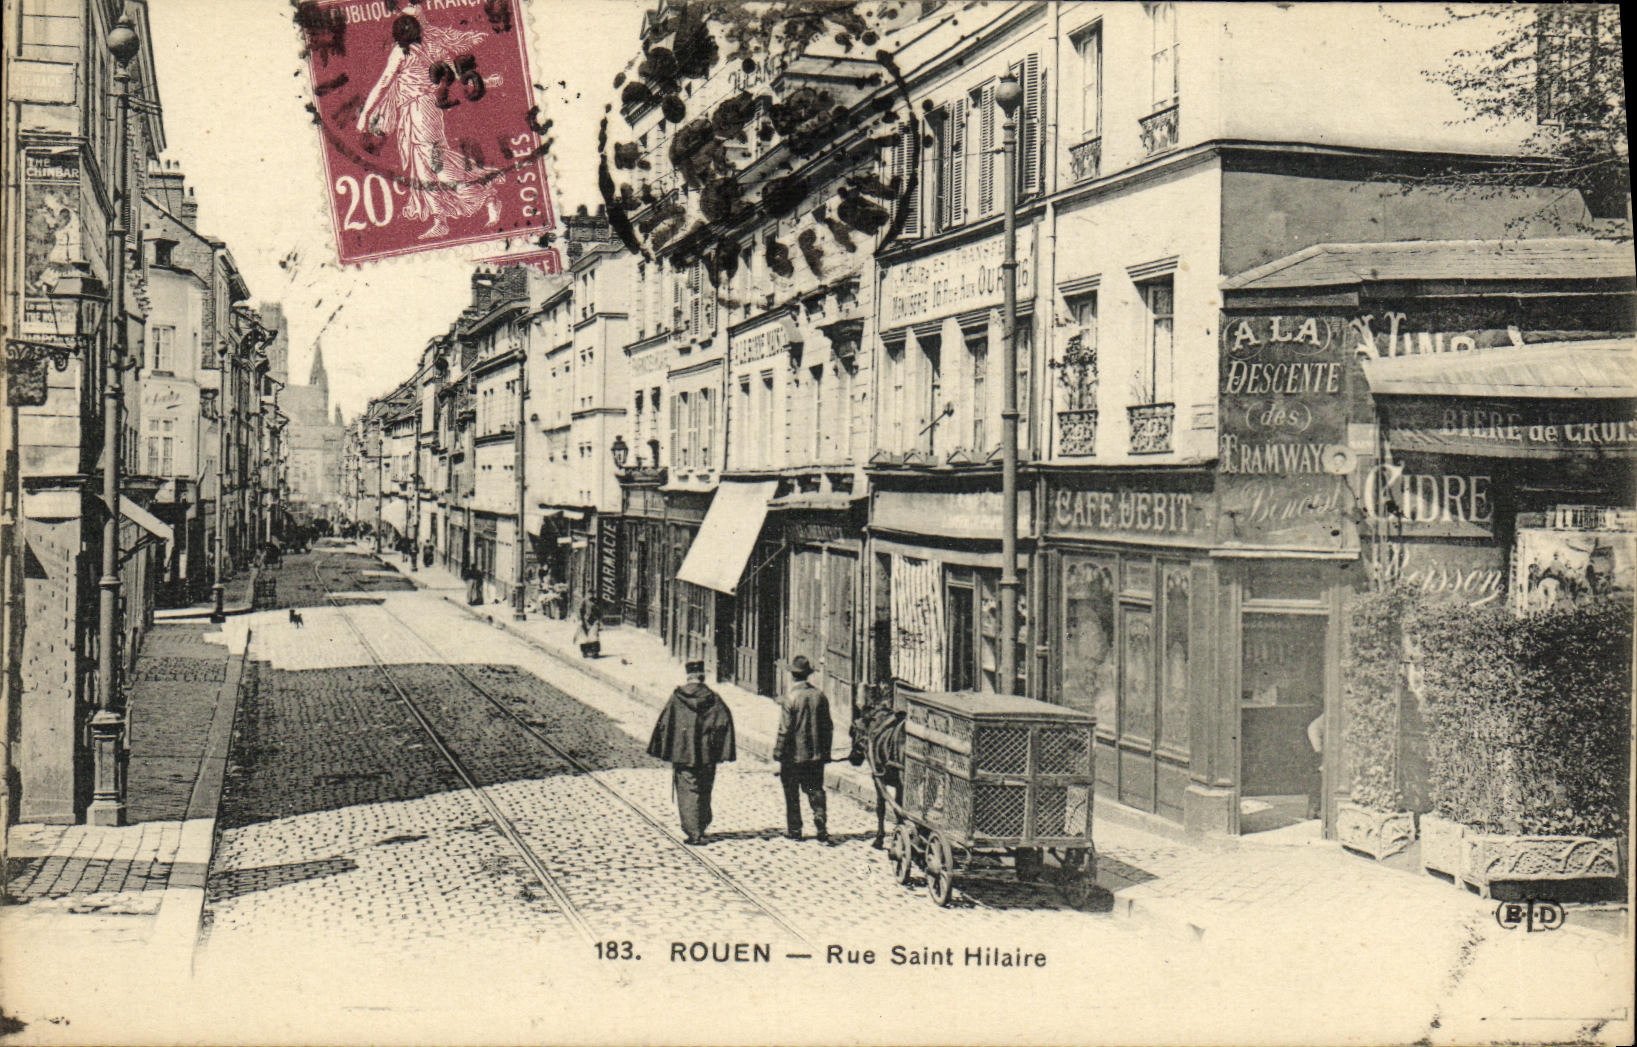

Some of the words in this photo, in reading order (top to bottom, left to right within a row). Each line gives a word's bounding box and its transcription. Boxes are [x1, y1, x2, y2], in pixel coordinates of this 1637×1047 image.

[1231, 320, 1261, 352] A
[1269, 315, 1321, 346] LA
[1221, 360, 1341, 395] DESCENTE
[1260, 402, 1300, 427] des
[1528, 423, 1559, 442] de
[1219, 433, 1327, 474] TRAMWAY
[1364, 461, 1494, 522] CIDRE
[602, 519, 617, 604] PHARMACIE
